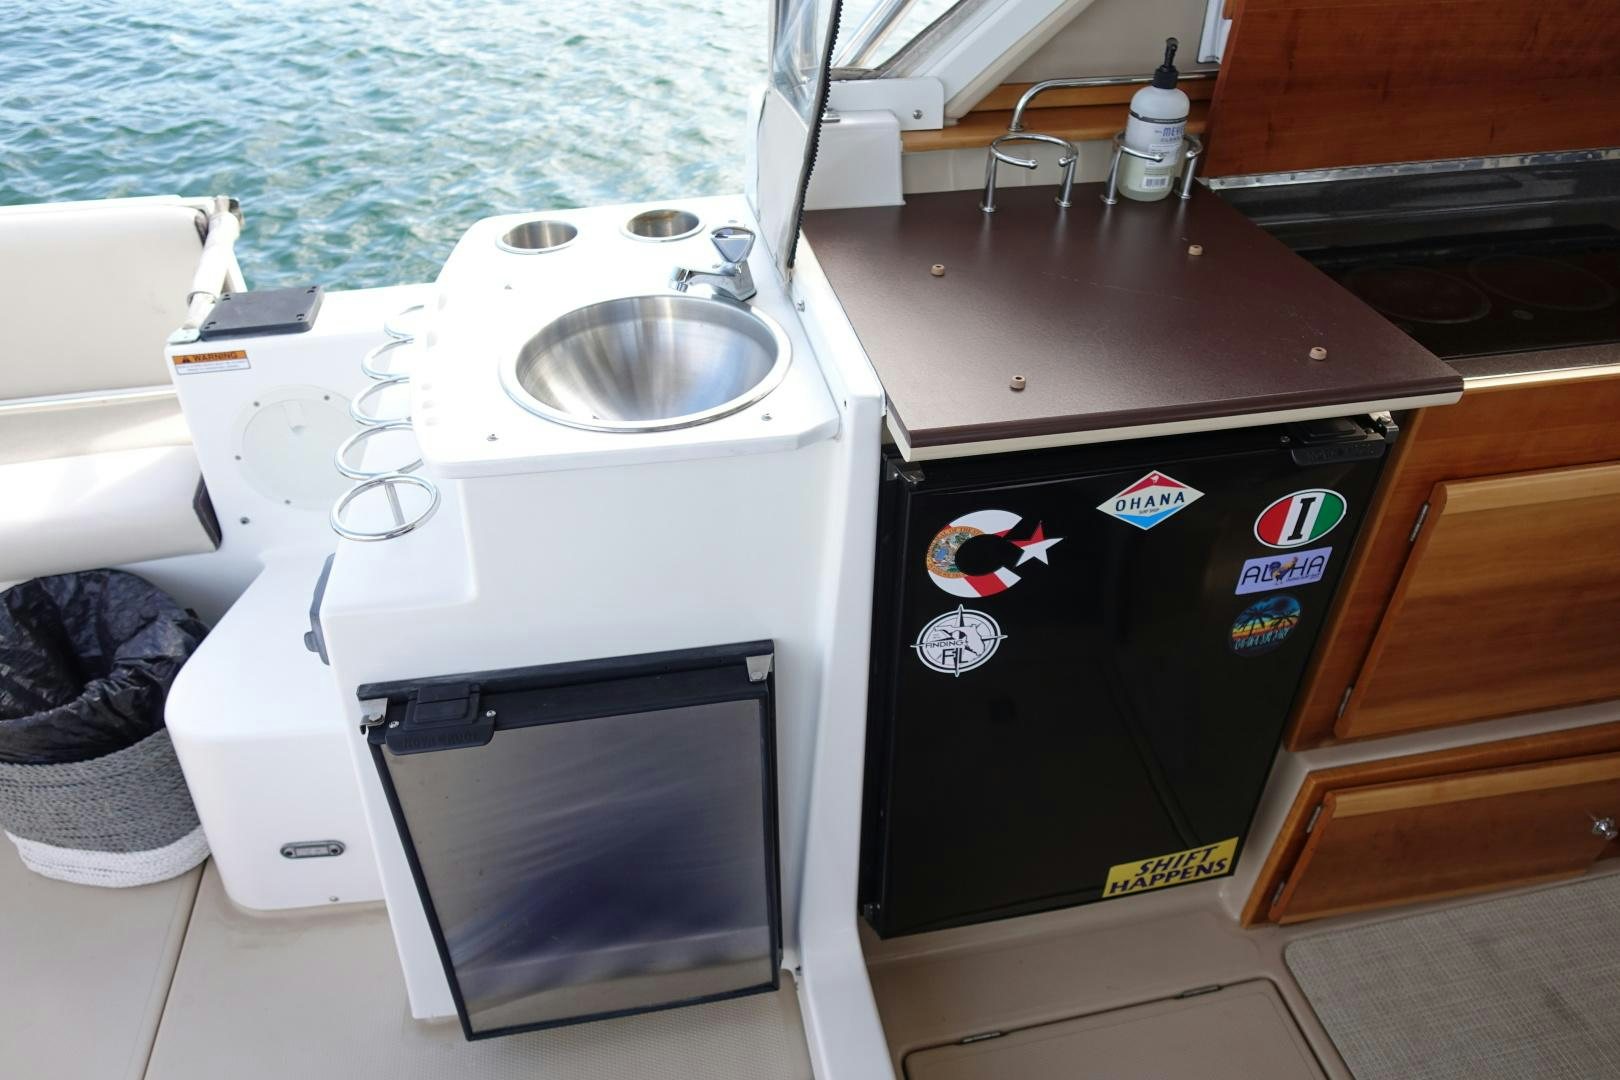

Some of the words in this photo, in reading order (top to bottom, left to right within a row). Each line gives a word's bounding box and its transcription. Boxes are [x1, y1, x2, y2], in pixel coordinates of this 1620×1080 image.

[194, 351, 238, 363] WARNING
[1115, 491, 1185, 512] OHANA
[1241, 555, 1325, 585] ALHA
[925, 640, 964, 648] FINDING
[1135, 845, 1220, 877] SHIFT
[1109, 858, 1228, 894] HAPPENS
